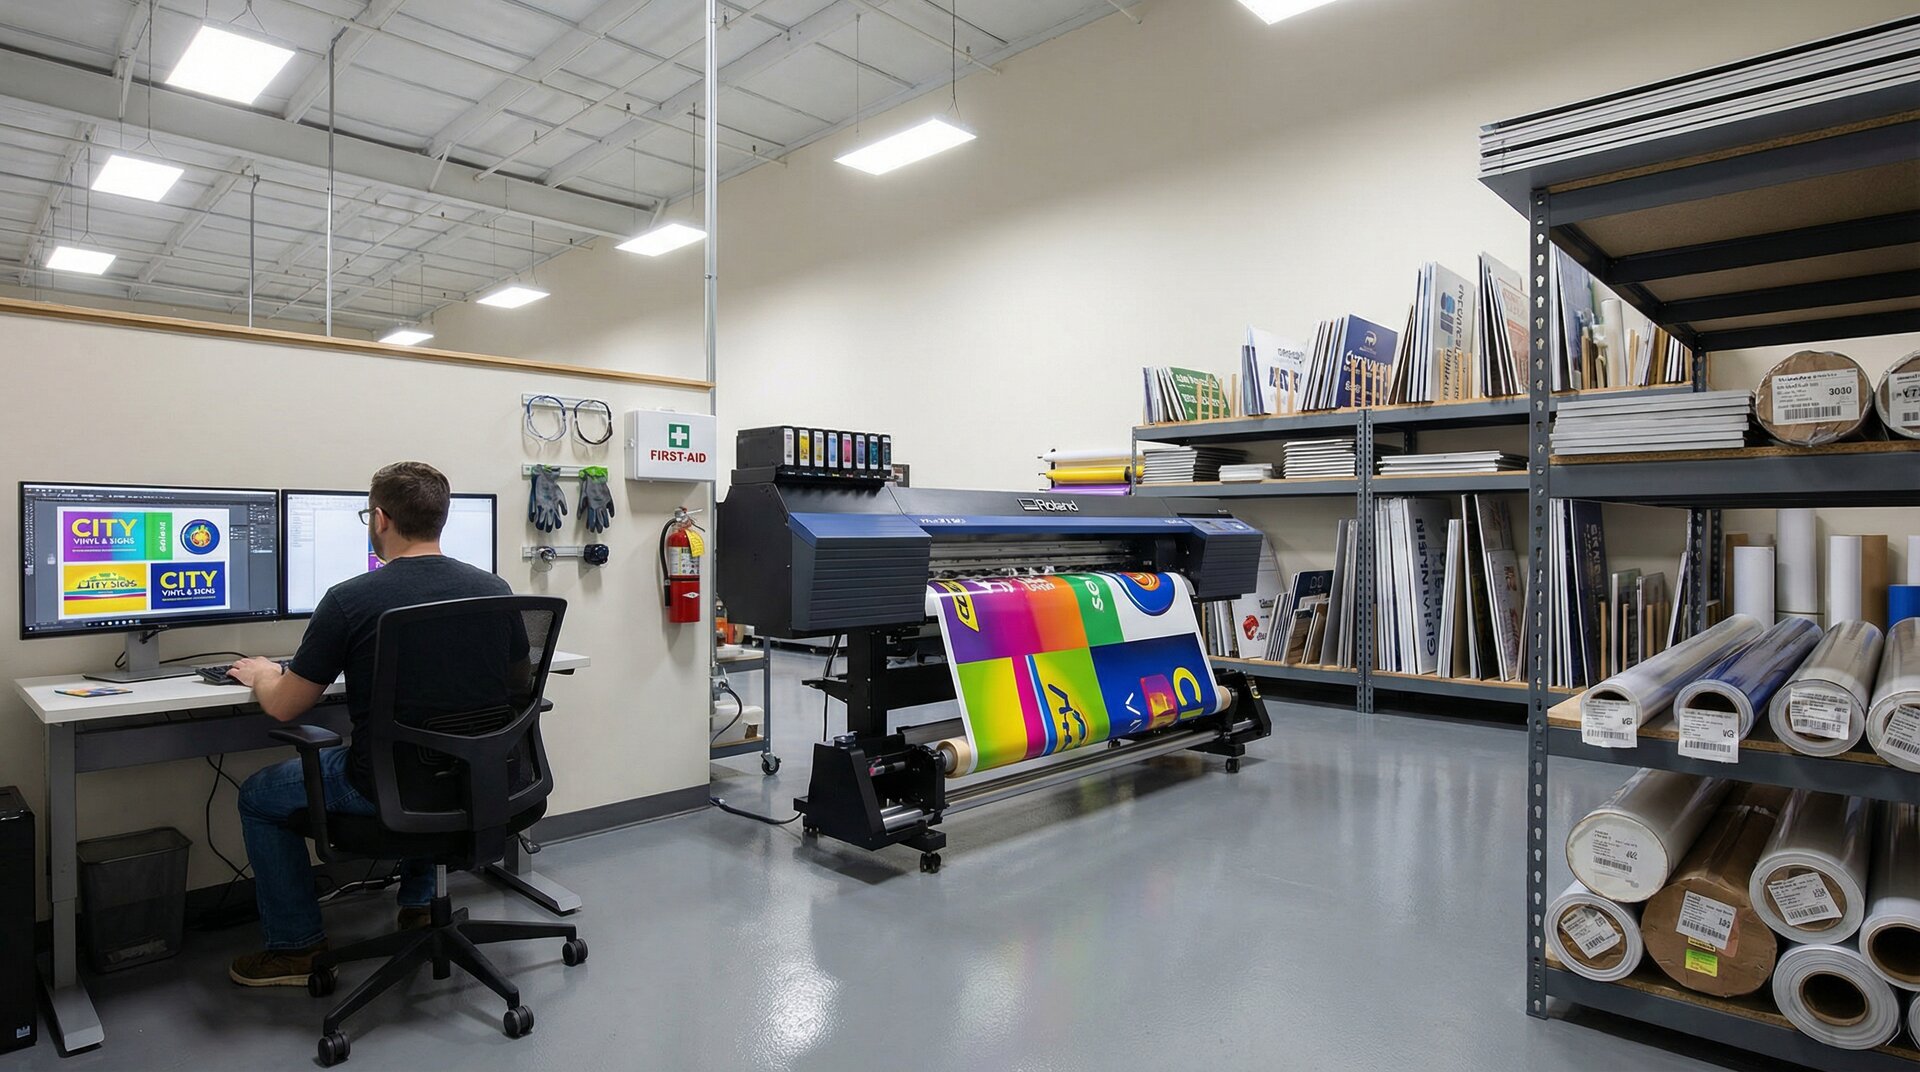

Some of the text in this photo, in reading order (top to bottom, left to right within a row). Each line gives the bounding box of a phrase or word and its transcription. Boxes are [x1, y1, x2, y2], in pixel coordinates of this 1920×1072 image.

[650, 450, 707, 463] FIRST-AID
[71, 518, 138, 537] CITY
[160, 570, 218, 589] CITY
